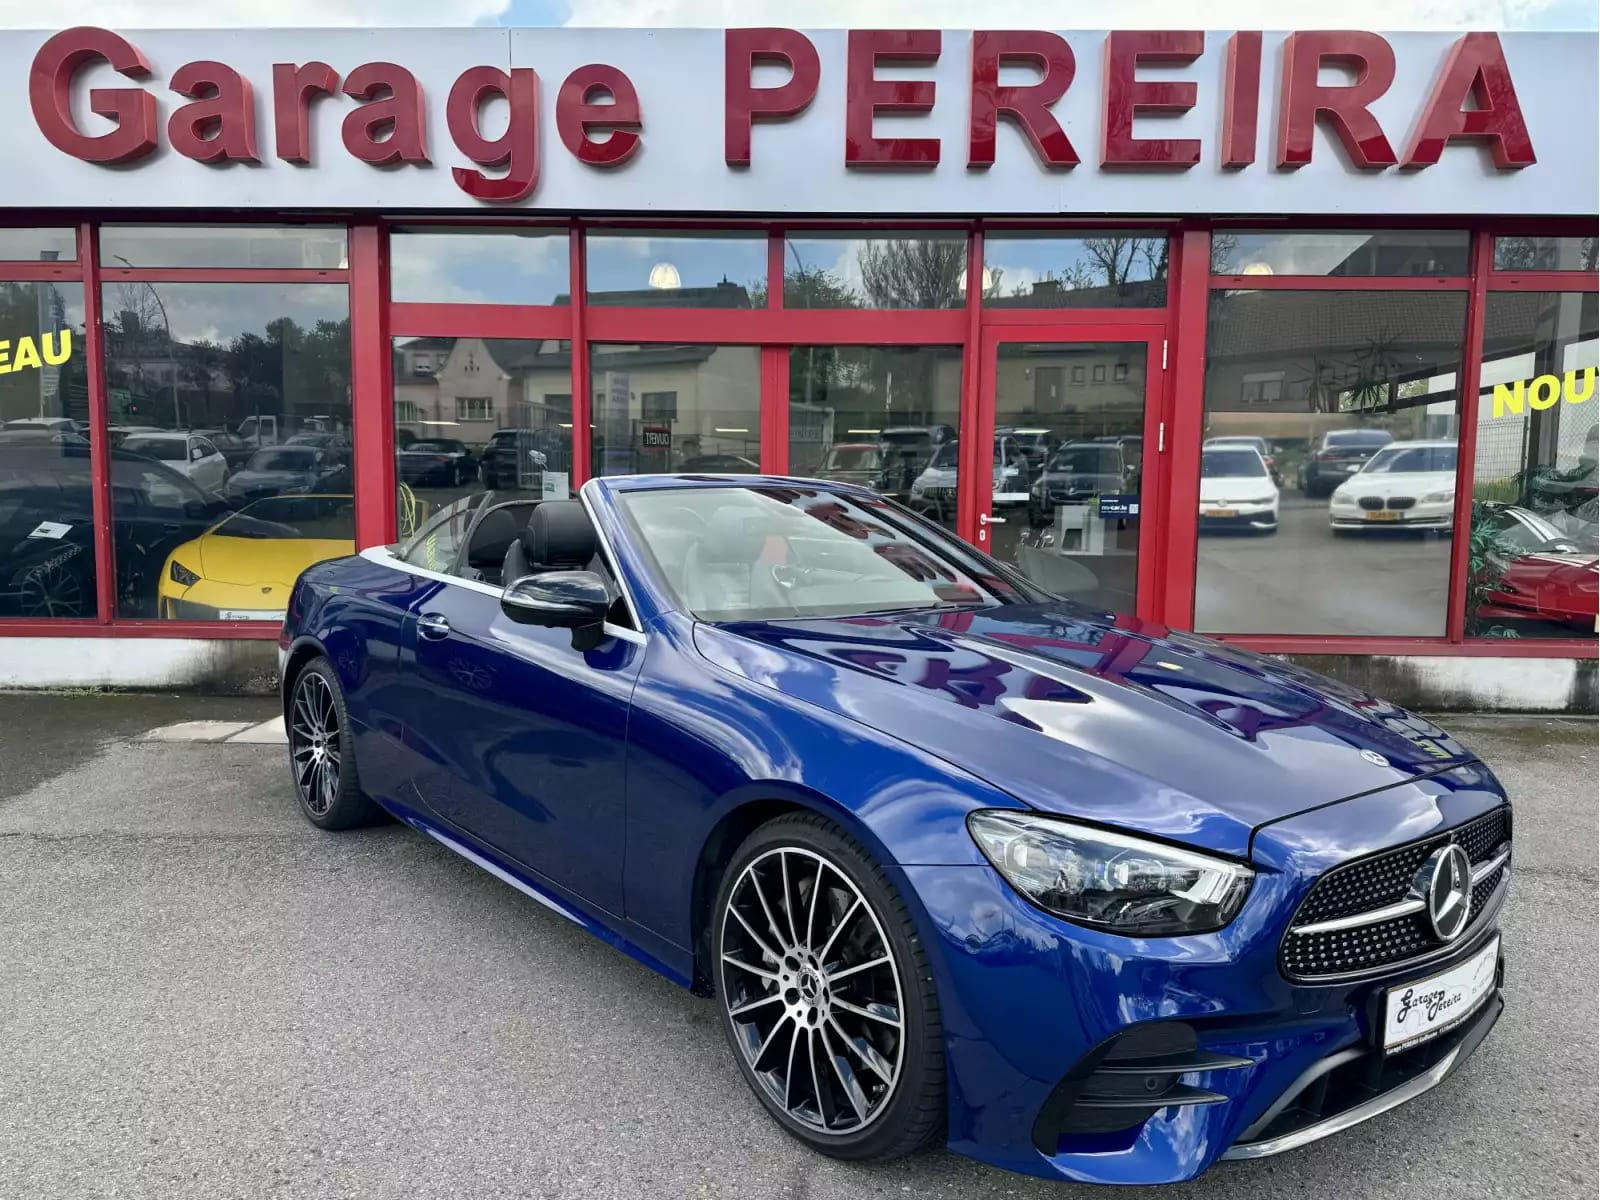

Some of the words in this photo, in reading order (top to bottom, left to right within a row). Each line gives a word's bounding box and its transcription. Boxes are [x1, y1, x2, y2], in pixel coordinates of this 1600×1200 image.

[29, 26, 643, 203] Garage
[724, 28, 1537, 171] PEREIRA
[0, 328, 72, 374] EAU
[1492, 366, 1599, 419] NOU
